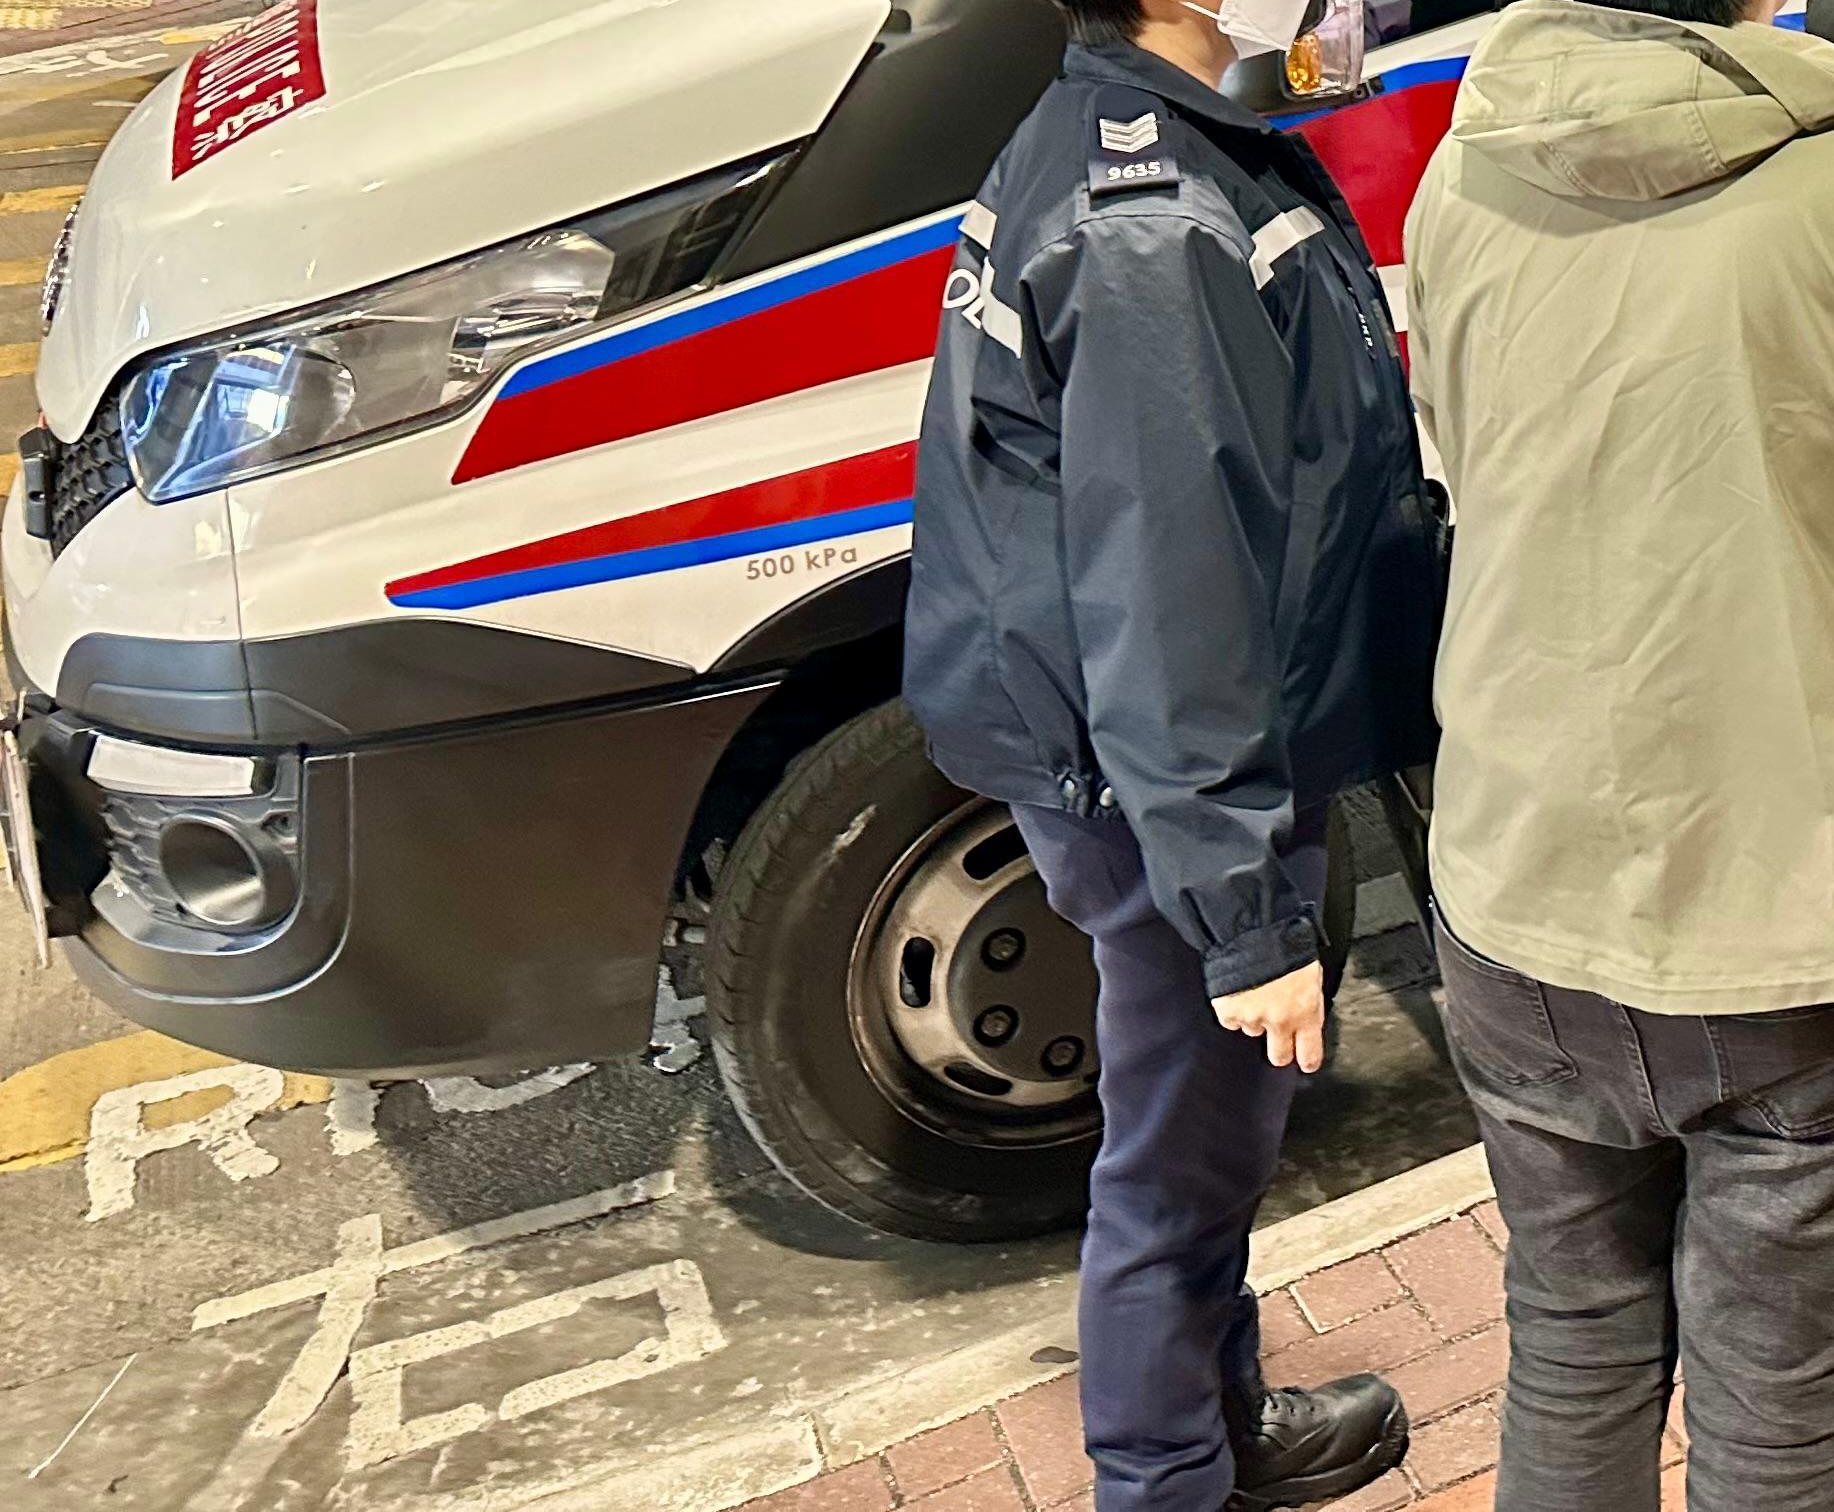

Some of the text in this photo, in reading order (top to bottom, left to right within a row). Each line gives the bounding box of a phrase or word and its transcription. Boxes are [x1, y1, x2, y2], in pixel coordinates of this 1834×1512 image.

[1107, 160, 1161, 181] 9635
[746, 547, 858, 580] 500 kPa
